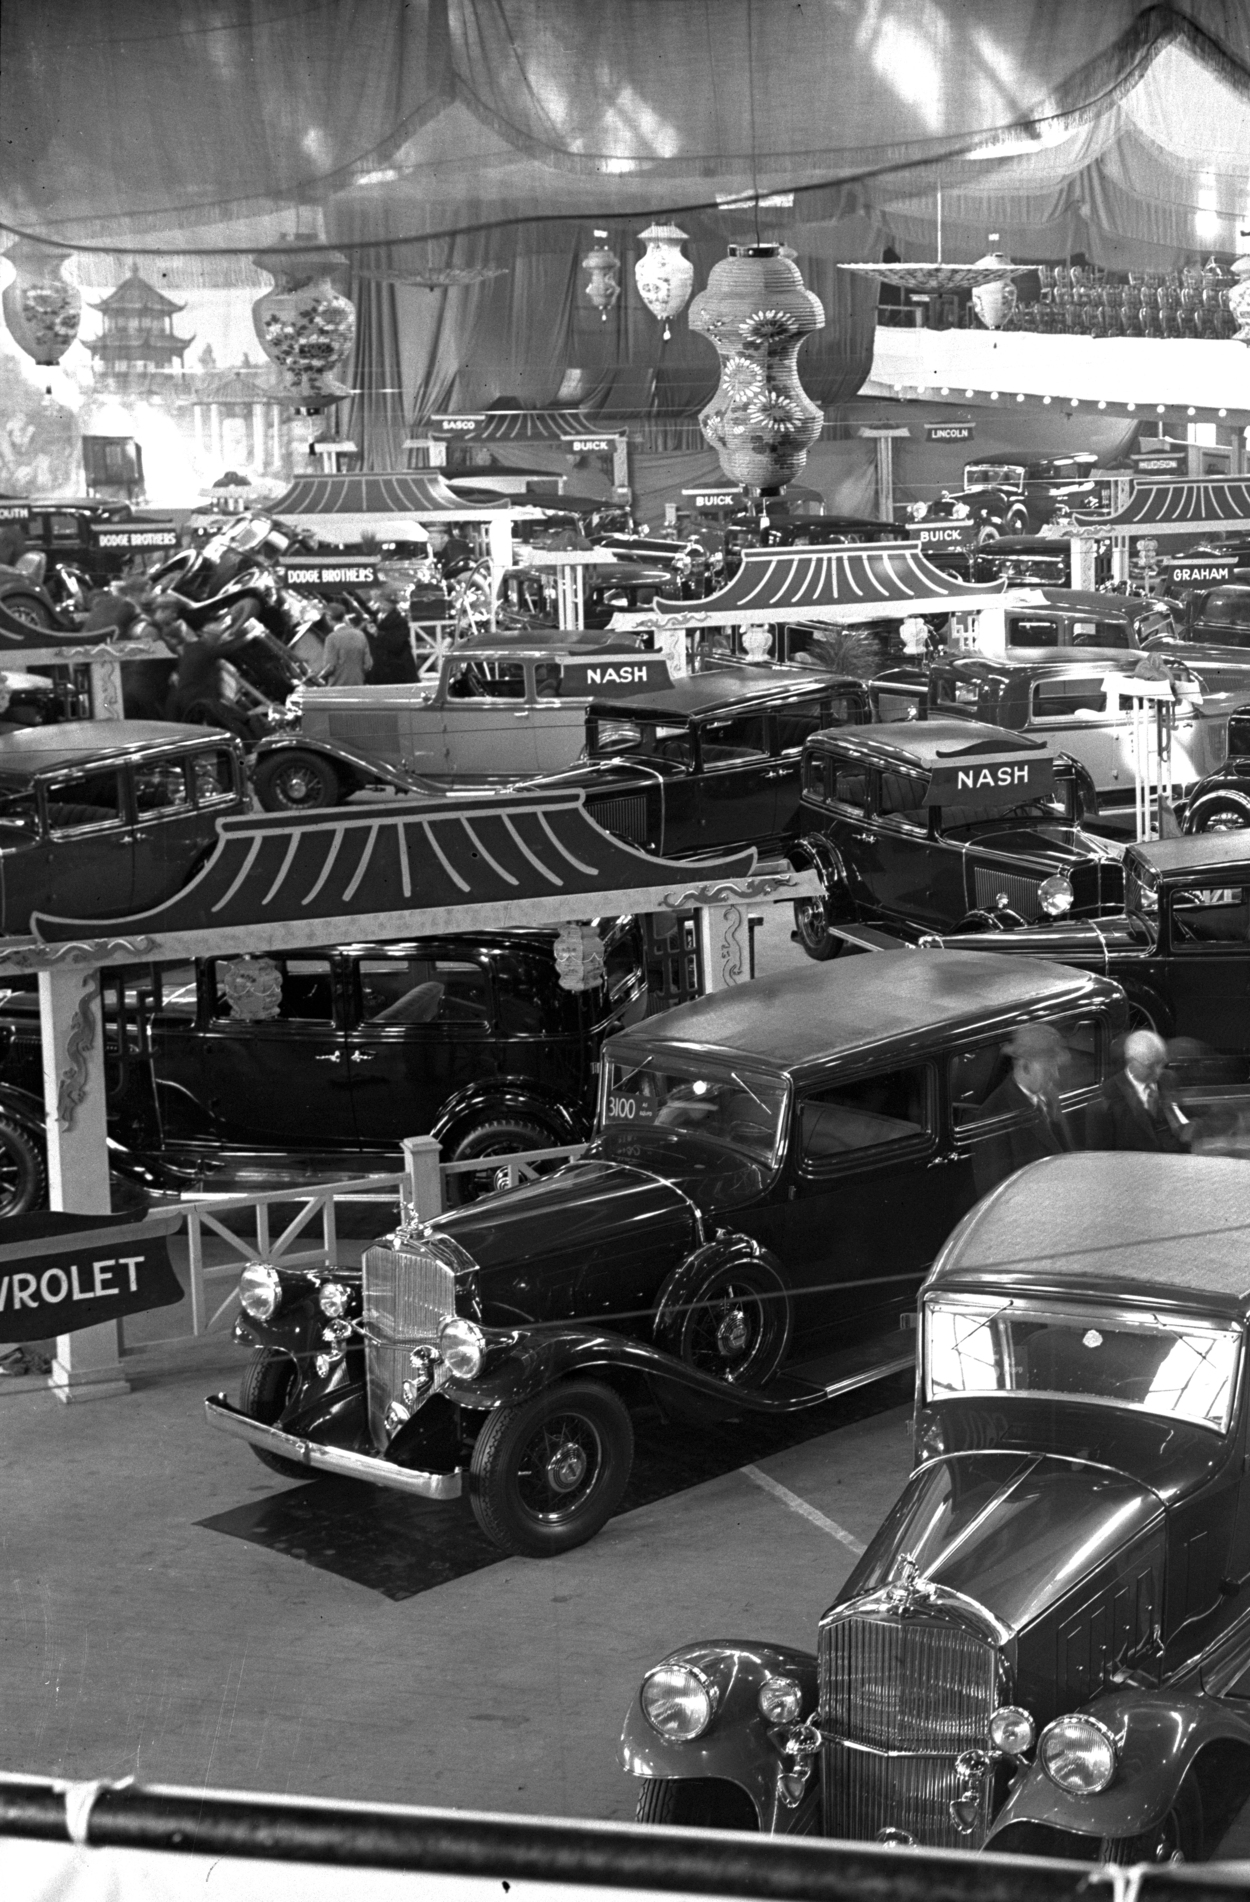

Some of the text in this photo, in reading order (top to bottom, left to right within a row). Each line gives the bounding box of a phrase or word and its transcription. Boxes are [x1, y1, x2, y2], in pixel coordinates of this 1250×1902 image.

[931, 429, 968, 439] LINCOLN
[573, 441, 608, 451] BUICK
[696, 495, 734, 507] BUICK
[99, 532, 177, 547] DODGE BROTHERS
[920, 529, 963, 543] BUICK
[287, 567, 374, 584] DODGE BROTHERS
[1173, 568, 1229, 582] GRAHAM
[586, 665, 648, 685] NASH
[957, 765, 1029, 790] NASH
[608, 1096, 636, 1119] 3100
